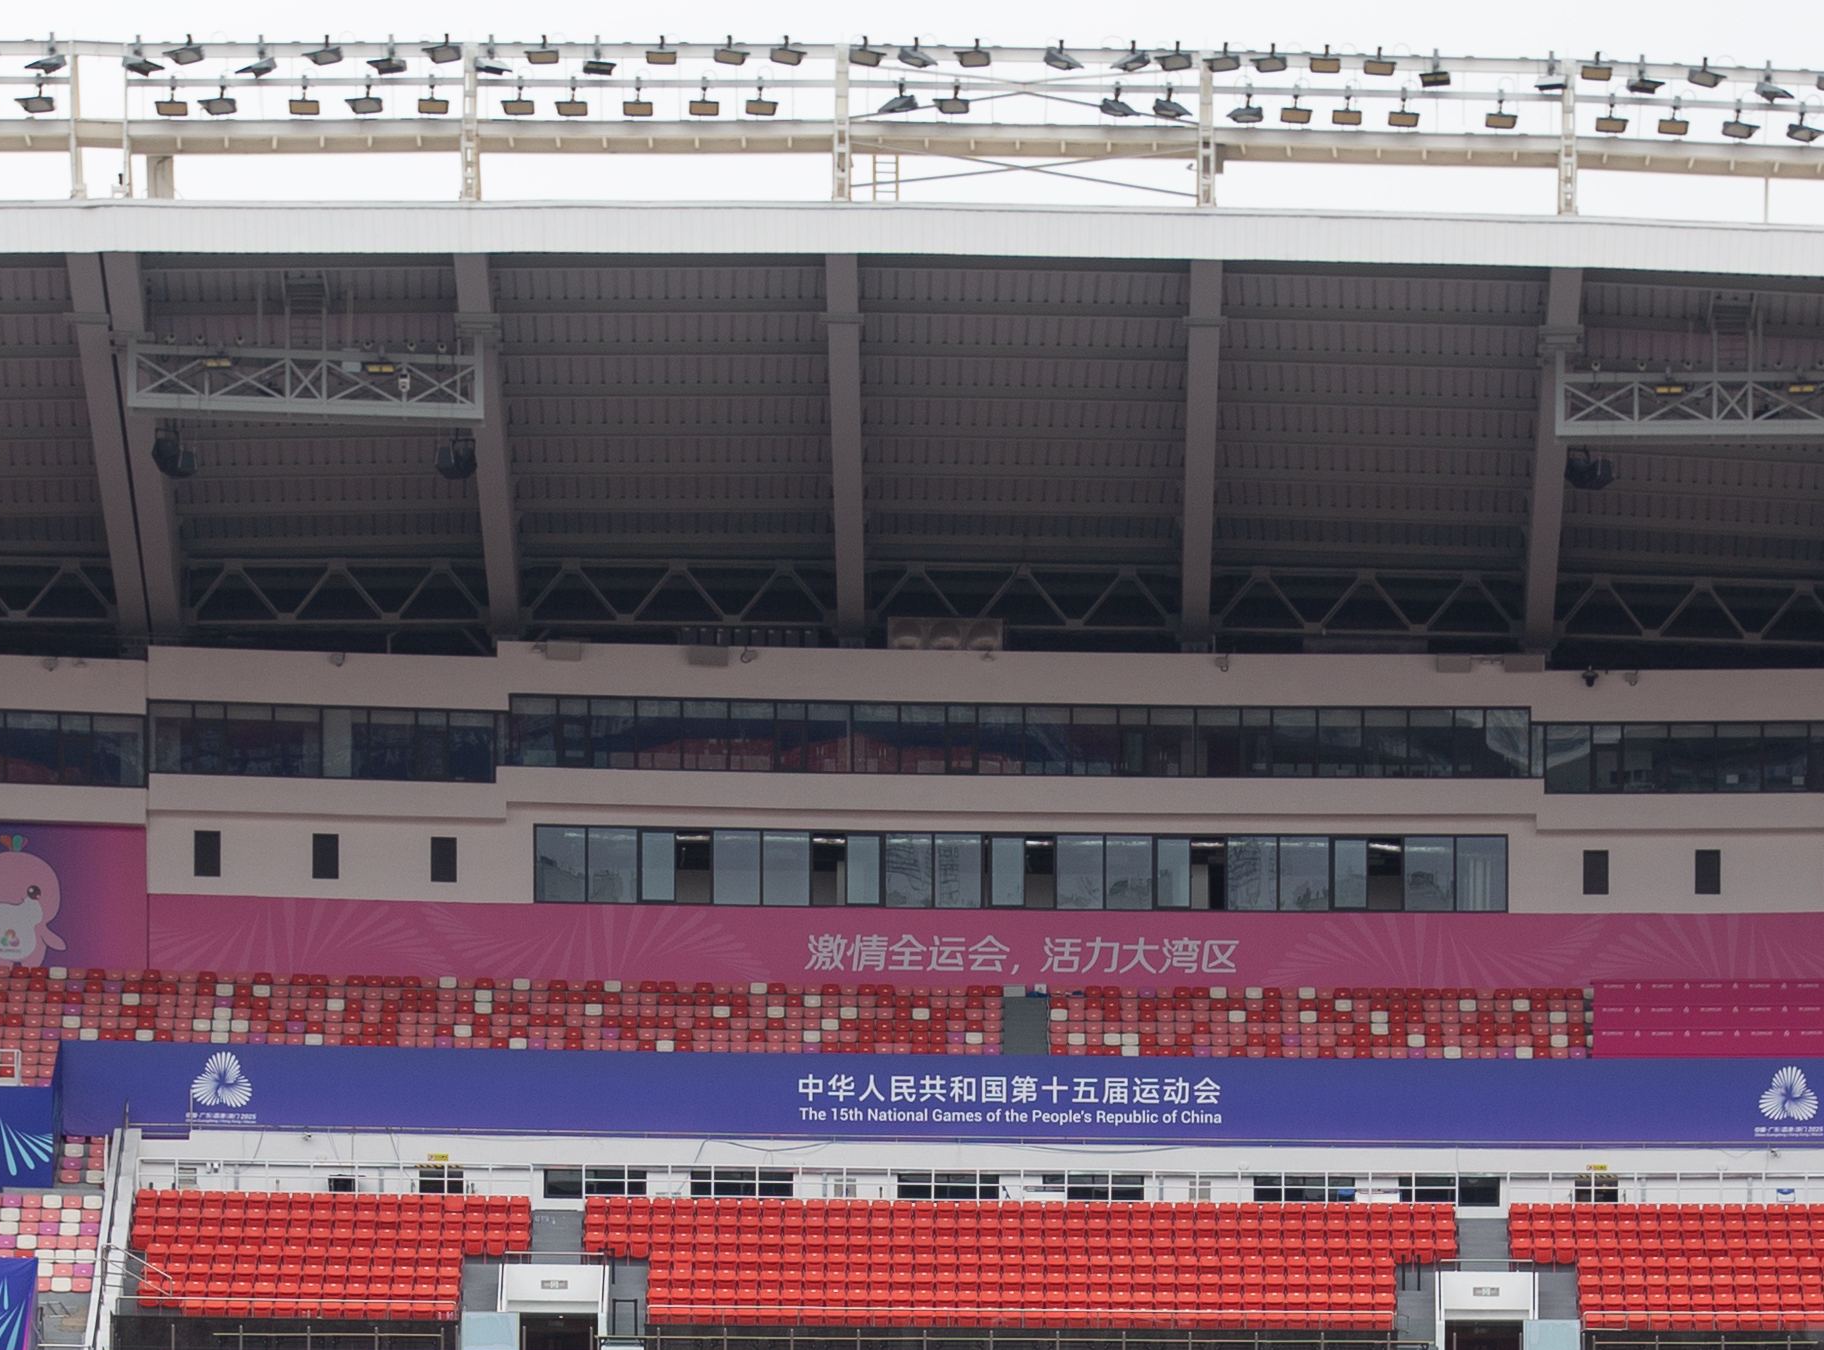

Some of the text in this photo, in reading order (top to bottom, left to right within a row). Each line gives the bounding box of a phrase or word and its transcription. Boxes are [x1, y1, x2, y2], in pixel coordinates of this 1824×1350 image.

[804, 933, 1240, 975] 激情全运会，活力大湾区
[798, 1073, 1221, 1105] 中华人民共和国第十五届运动会
[799, 1108, 1222, 1126] The 15th National Games of the People's Republic of China
